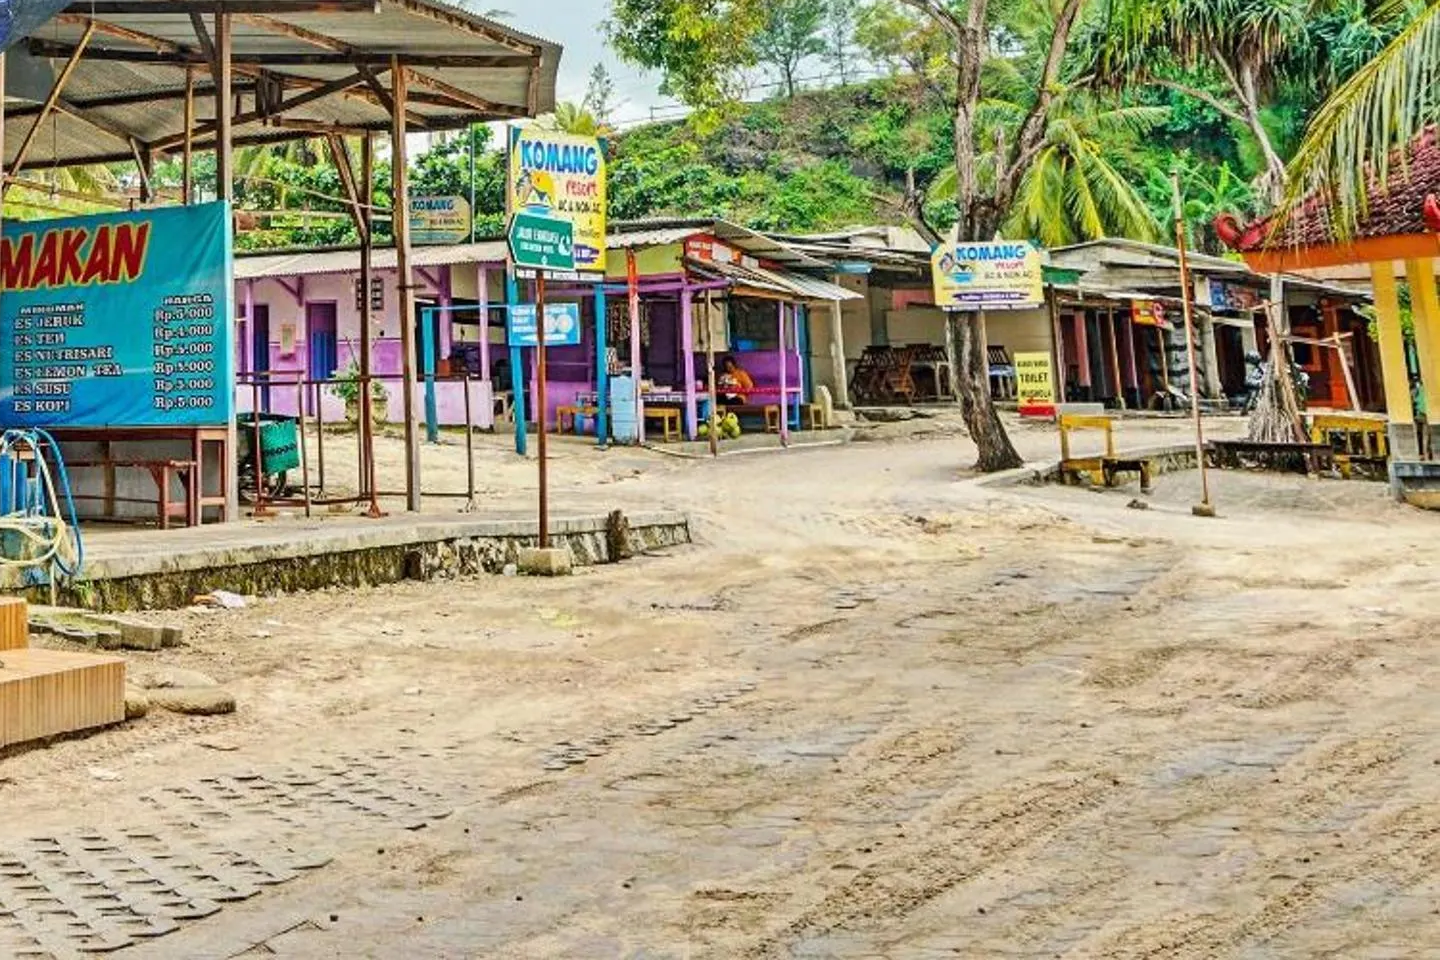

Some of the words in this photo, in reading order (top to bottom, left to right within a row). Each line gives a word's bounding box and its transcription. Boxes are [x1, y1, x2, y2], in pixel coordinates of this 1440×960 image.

[520, 140, 598, 175] KOMANG
[411, 199, 454, 210] KOMANG
[0, 222, 151, 291] MAKAN
[956, 245, 1026, 261] KOMANG
[164, 295, 212, 305] HARGA
[14, 318, 33, 329] ES
[35, 315, 84, 328] JERUK
[14, 335, 33, 346] ES
[35, 333, 65, 345] TEH
[14, 351, 33, 362] ES
[35, 347, 114, 361] NUTRISARI
[14, 368, 33, 379] ES
[34, 366, 86, 379] LEMON
[94, 364, 124, 376] TEA
[1020, 372, 1048, 384] TOILET
[34, 383, 71, 395] SUSU
[14, 400, 33, 411] ES
[35, 399, 70, 411] KOPI
